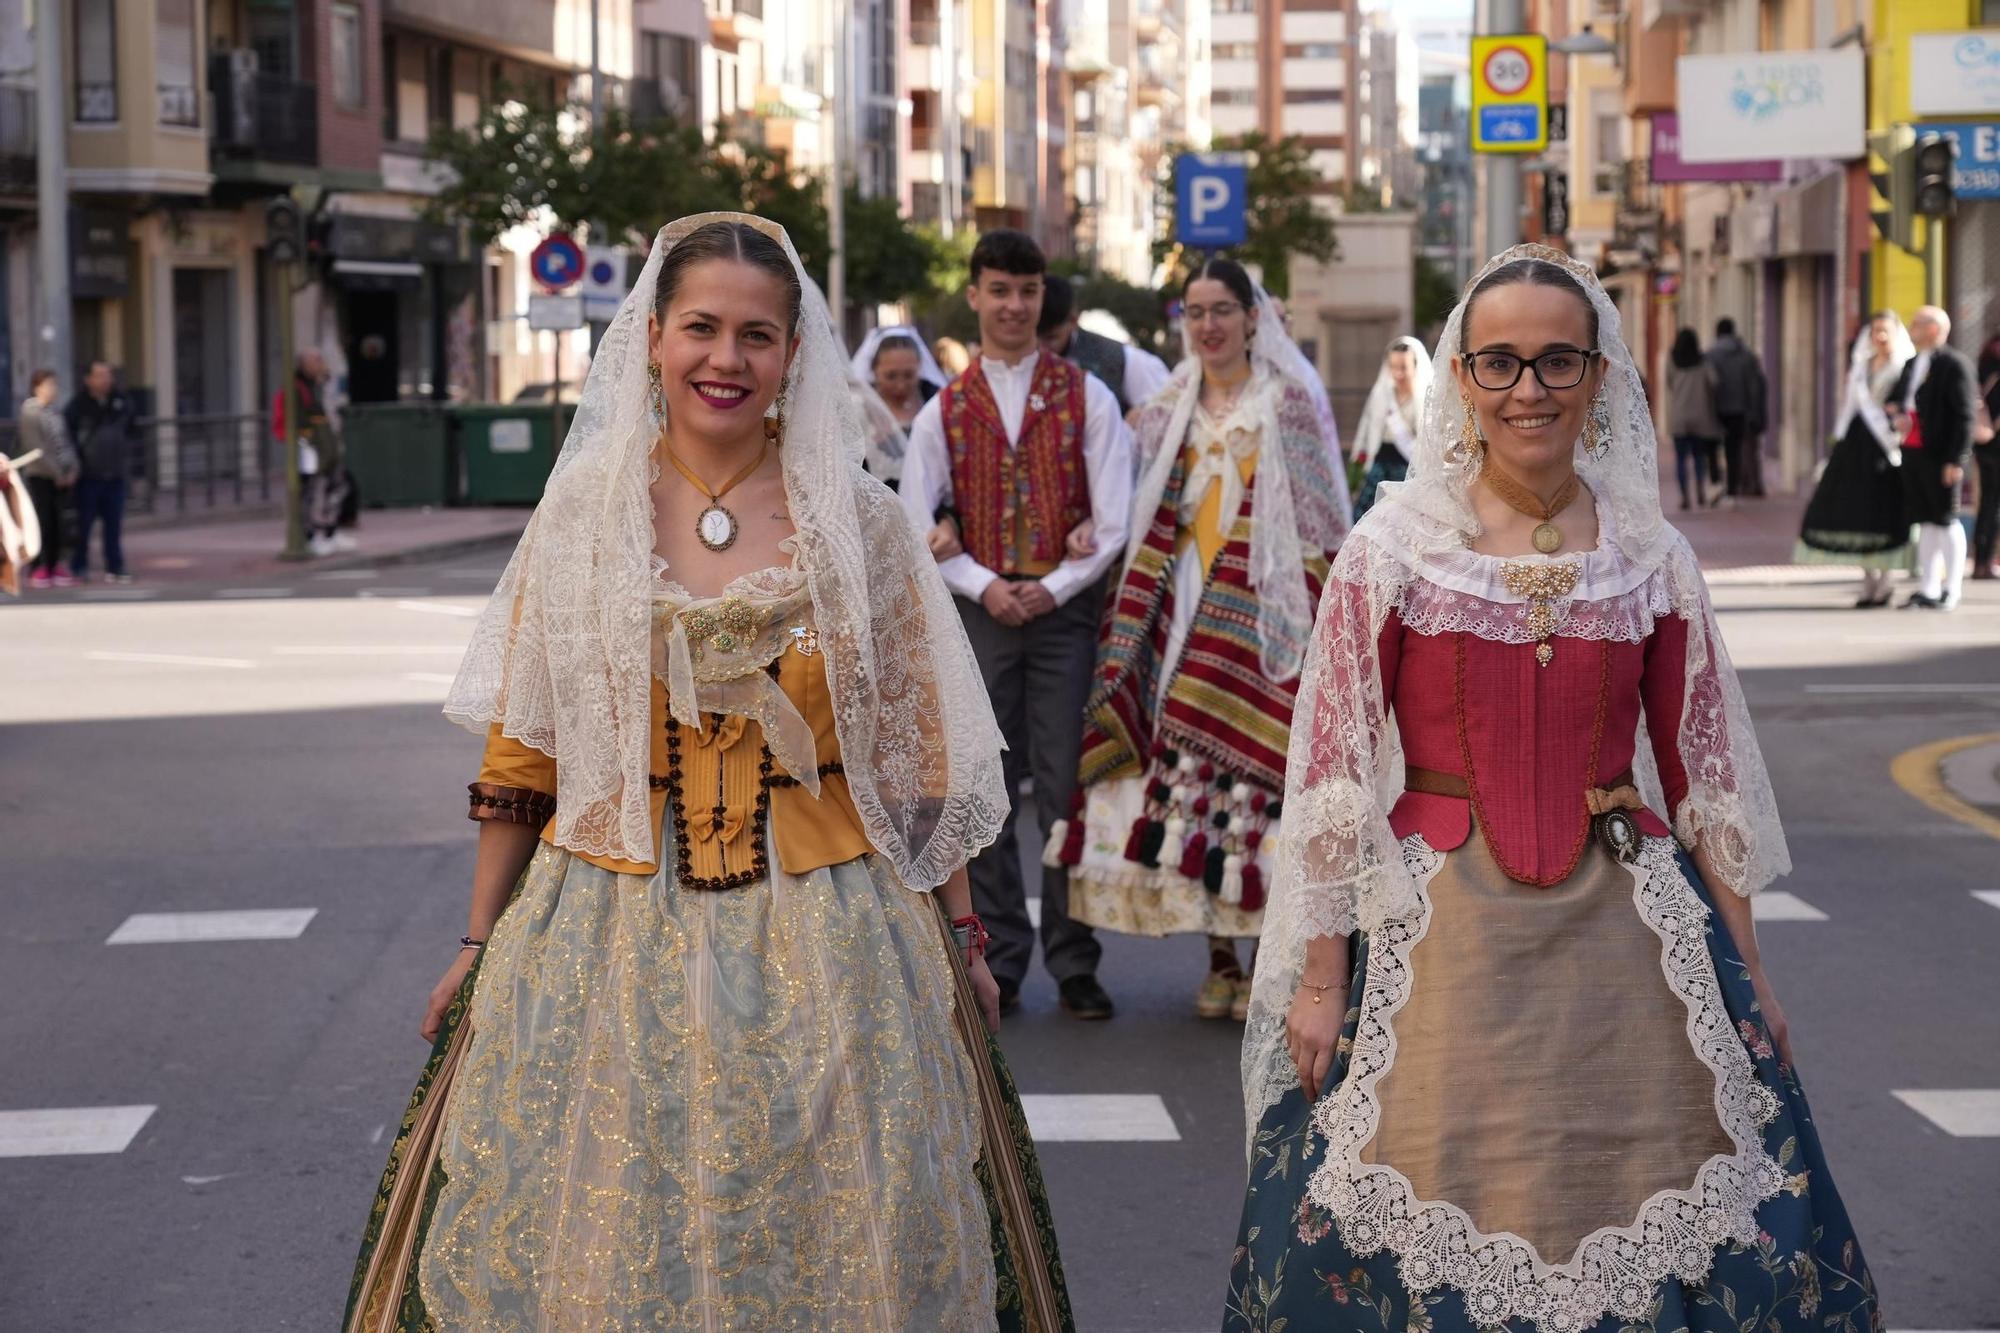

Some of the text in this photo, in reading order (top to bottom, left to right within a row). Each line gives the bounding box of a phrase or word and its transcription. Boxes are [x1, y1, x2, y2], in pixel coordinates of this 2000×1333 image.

[1494, 60, 1526, 81] 30
[1190, 176, 1230, 224] P
[546, 253, 567, 275] P
